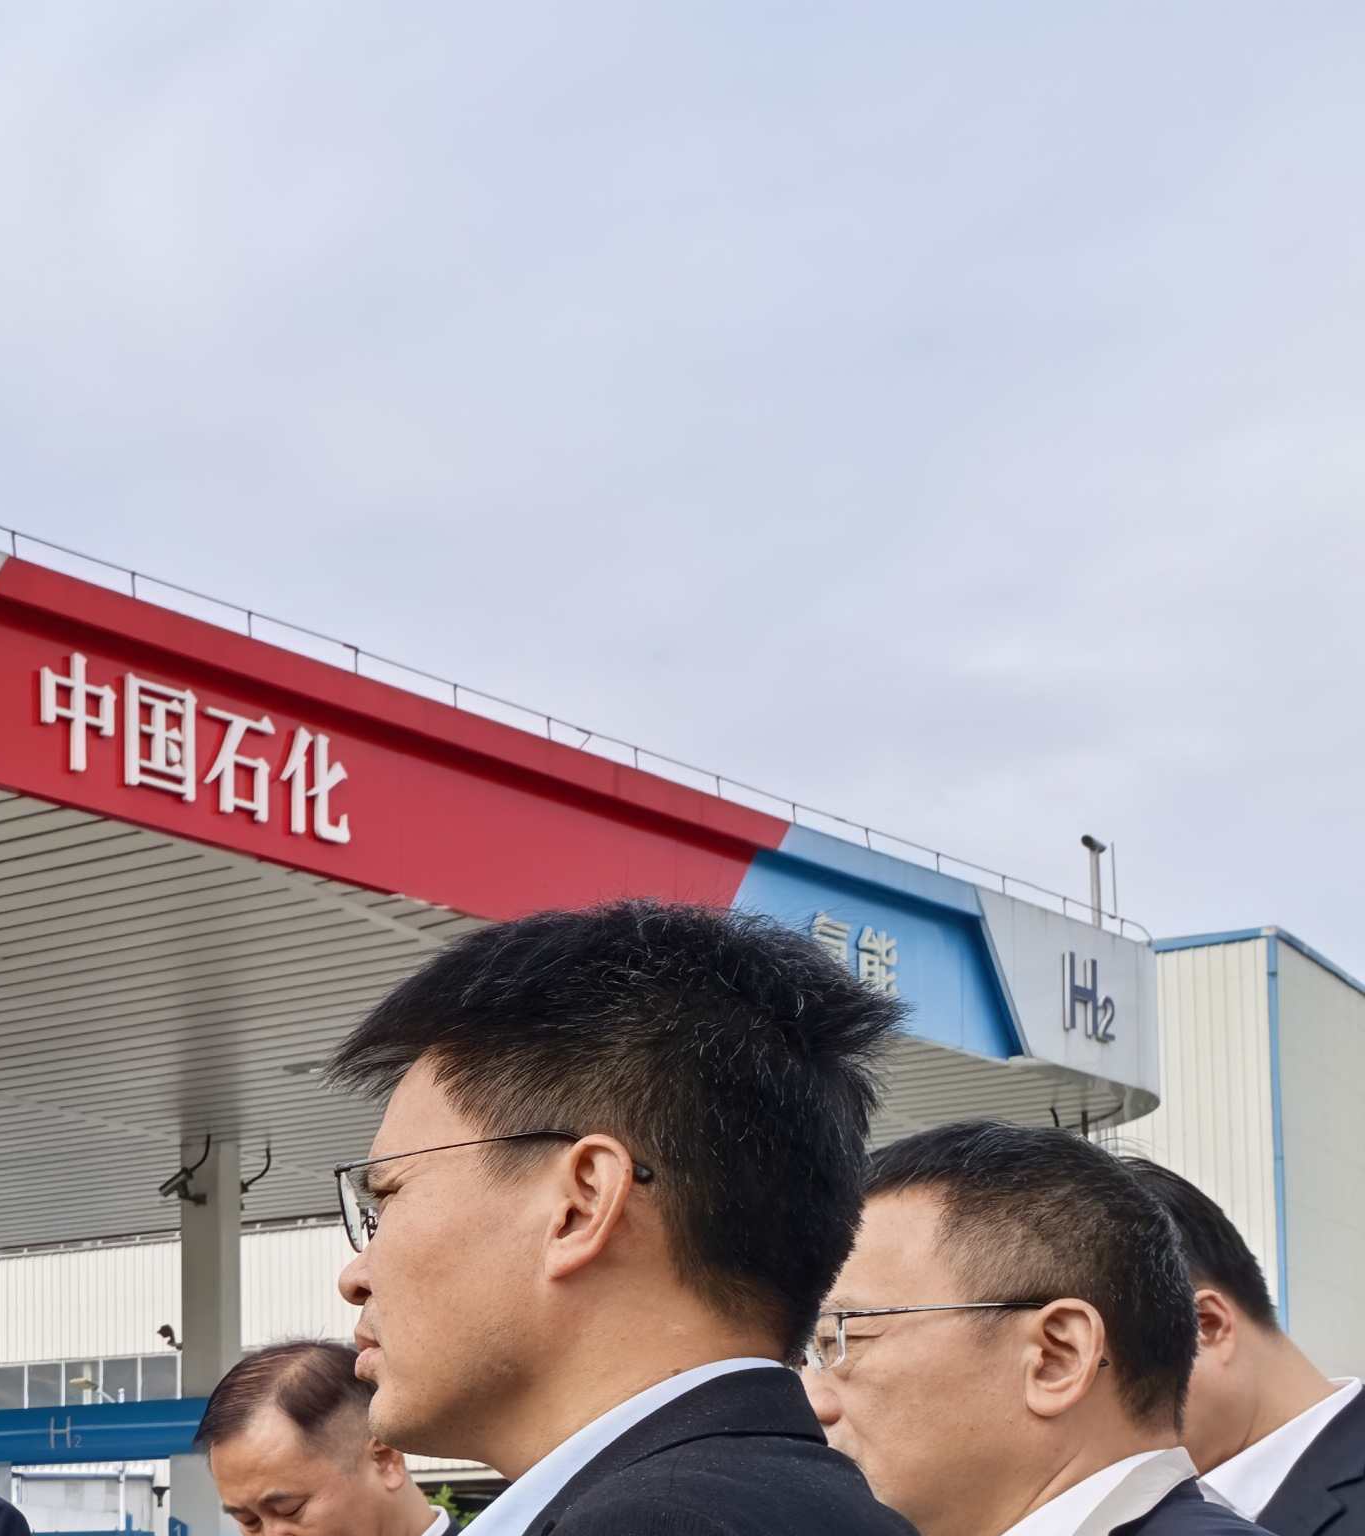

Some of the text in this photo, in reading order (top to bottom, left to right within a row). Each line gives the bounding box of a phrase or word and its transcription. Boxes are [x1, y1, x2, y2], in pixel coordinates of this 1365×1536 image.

[40, 651, 351, 845] 中国石化
[1061, 950, 1117, 1043] H2
[49, 1415, 83, 1449] H2
